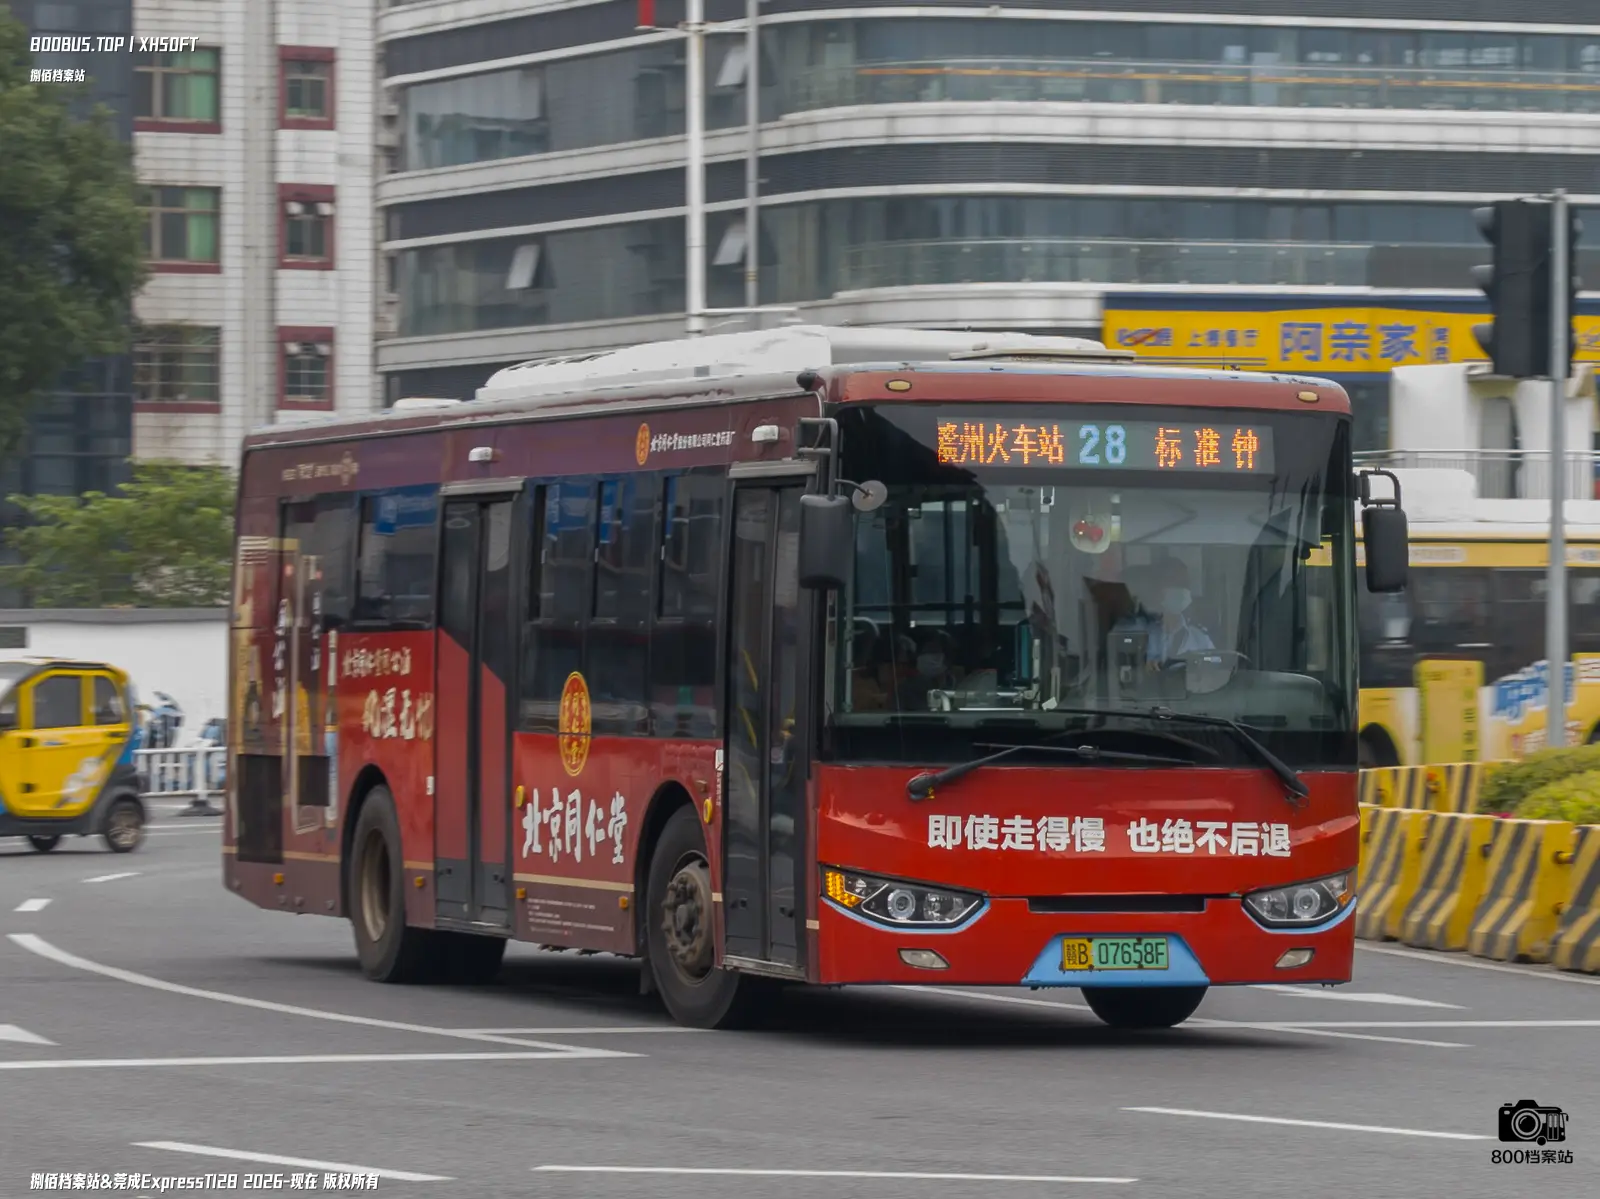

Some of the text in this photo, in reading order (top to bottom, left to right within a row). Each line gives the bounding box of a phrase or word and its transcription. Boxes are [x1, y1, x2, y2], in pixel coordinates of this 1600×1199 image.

[1079, 424, 1126, 464] 28
[522, 787, 627, 864] 北京同仁堂
[927, 814, 1292, 858] 即使走得慢 也绝不后退
[1098, 942, 1166, 965] 07658F
